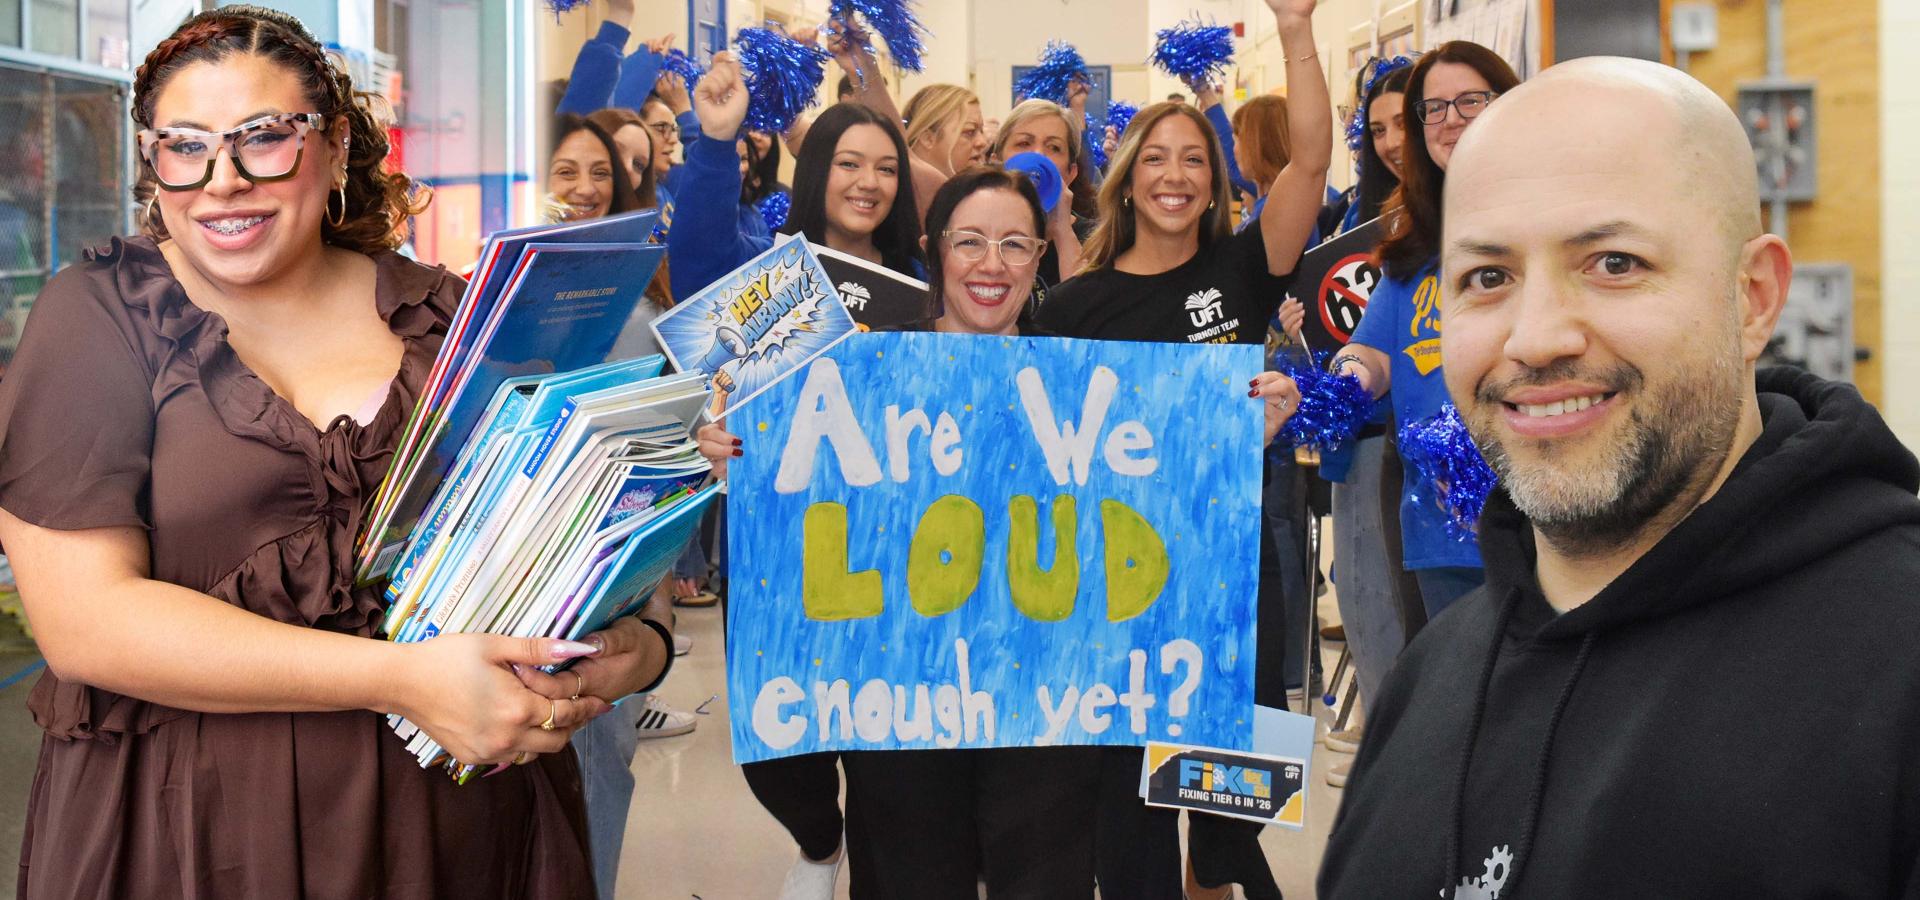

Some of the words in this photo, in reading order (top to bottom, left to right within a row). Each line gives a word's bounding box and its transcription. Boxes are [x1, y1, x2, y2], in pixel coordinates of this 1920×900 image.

[728, 273, 772, 325] HEY
[740, 272, 813, 348] ALBANY!
[1190, 301, 1224, 328] UFT
[1187, 325, 1220, 343] TURNOUT
[1220, 318, 1239, 331] TEAM
[527, 452, 542, 474] RANDOM
[540, 436, 552, 453] HOUSE
[550, 418, 563, 436] STUDIO
[775, 357, 963, 494] Are
[1016, 366, 1159, 487] We
[455, 560, 478, 594] Promise
[803, 494, 1170, 623] LOUD
[752, 639, 995, 749] enough
[1034, 639, 1203, 746] yet?
[1179, 788, 1210, 802] FIXING
[1212, 792, 1233, 806] TIER
[1234, 797, 1241, 806] 6
[1243, 797, 1254, 808] IN
[1256, 799, 1271, 810] '26
[1285, 772, 1300, 780] UFT
